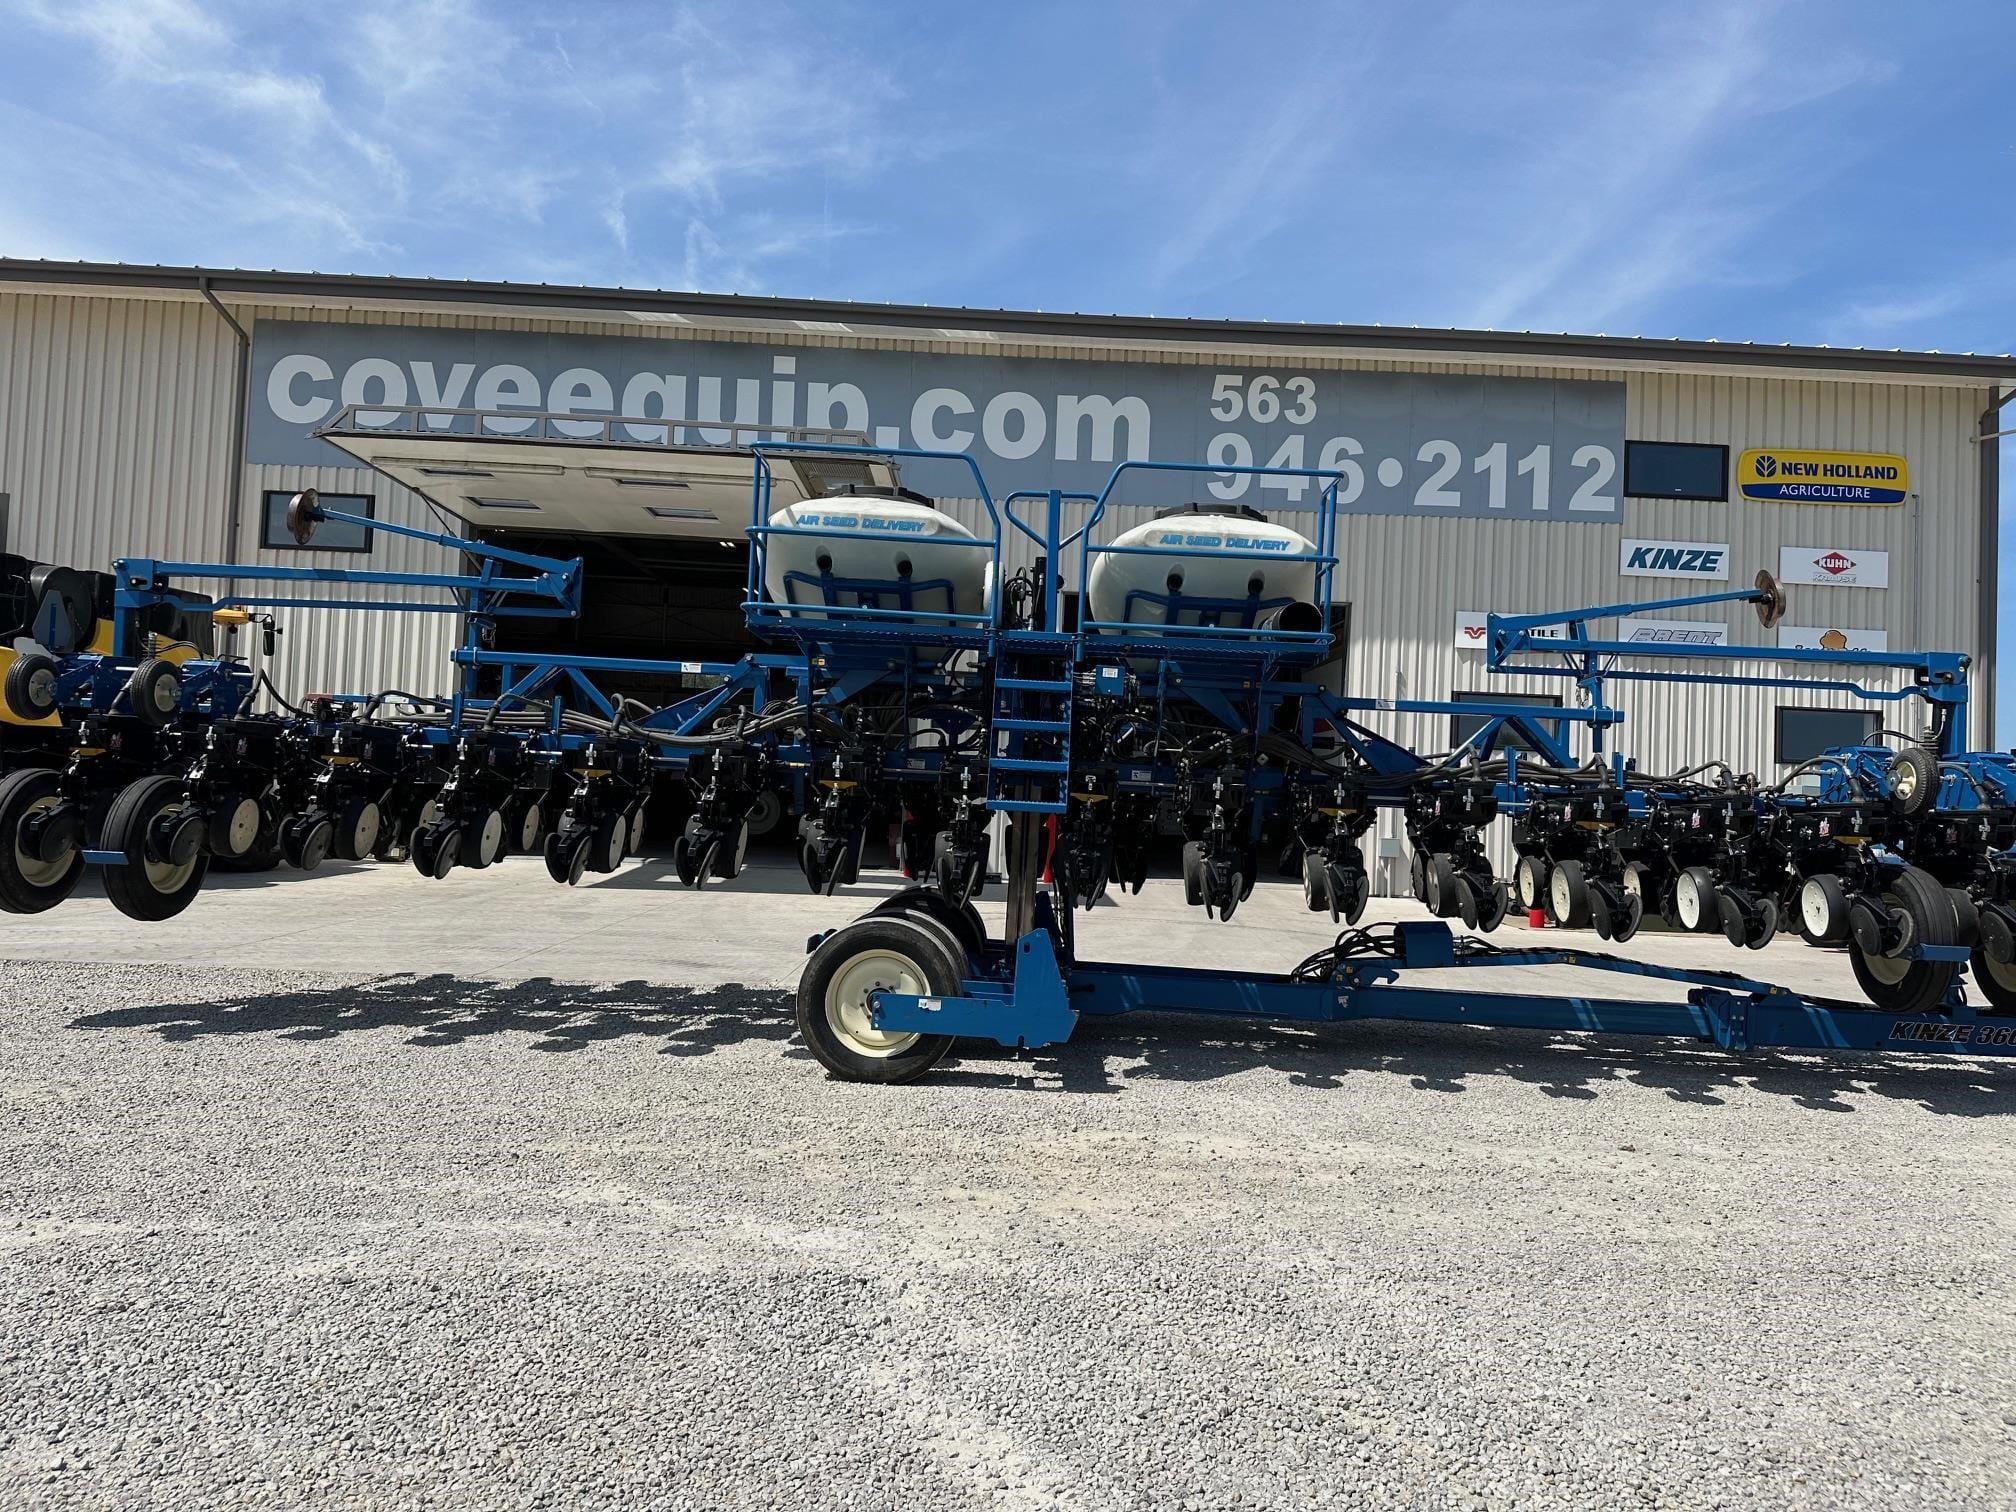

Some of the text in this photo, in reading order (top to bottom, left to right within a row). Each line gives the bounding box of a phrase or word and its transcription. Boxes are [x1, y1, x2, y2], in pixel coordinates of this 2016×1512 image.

[267, 354, 1151, 462] coveequip.com
[1210, 374, 1317, 425] 563
[1781, 462, 1898, 480] NEW HOLLAND
[1779, 484, 1871, 498] AGRICULTURE
[797, 515, 925, 531] AIR SEED DELIVERY
[1160, 534, 1290, 551] AIR SEED DELIVERY
[1627, 547, 1723, 572] KINZE
[1818, 558, 1852, 569] KUHN
[1628, 628, 1722, 645] BRENT
[1888, 1021, 1975, 1044] KINZE
